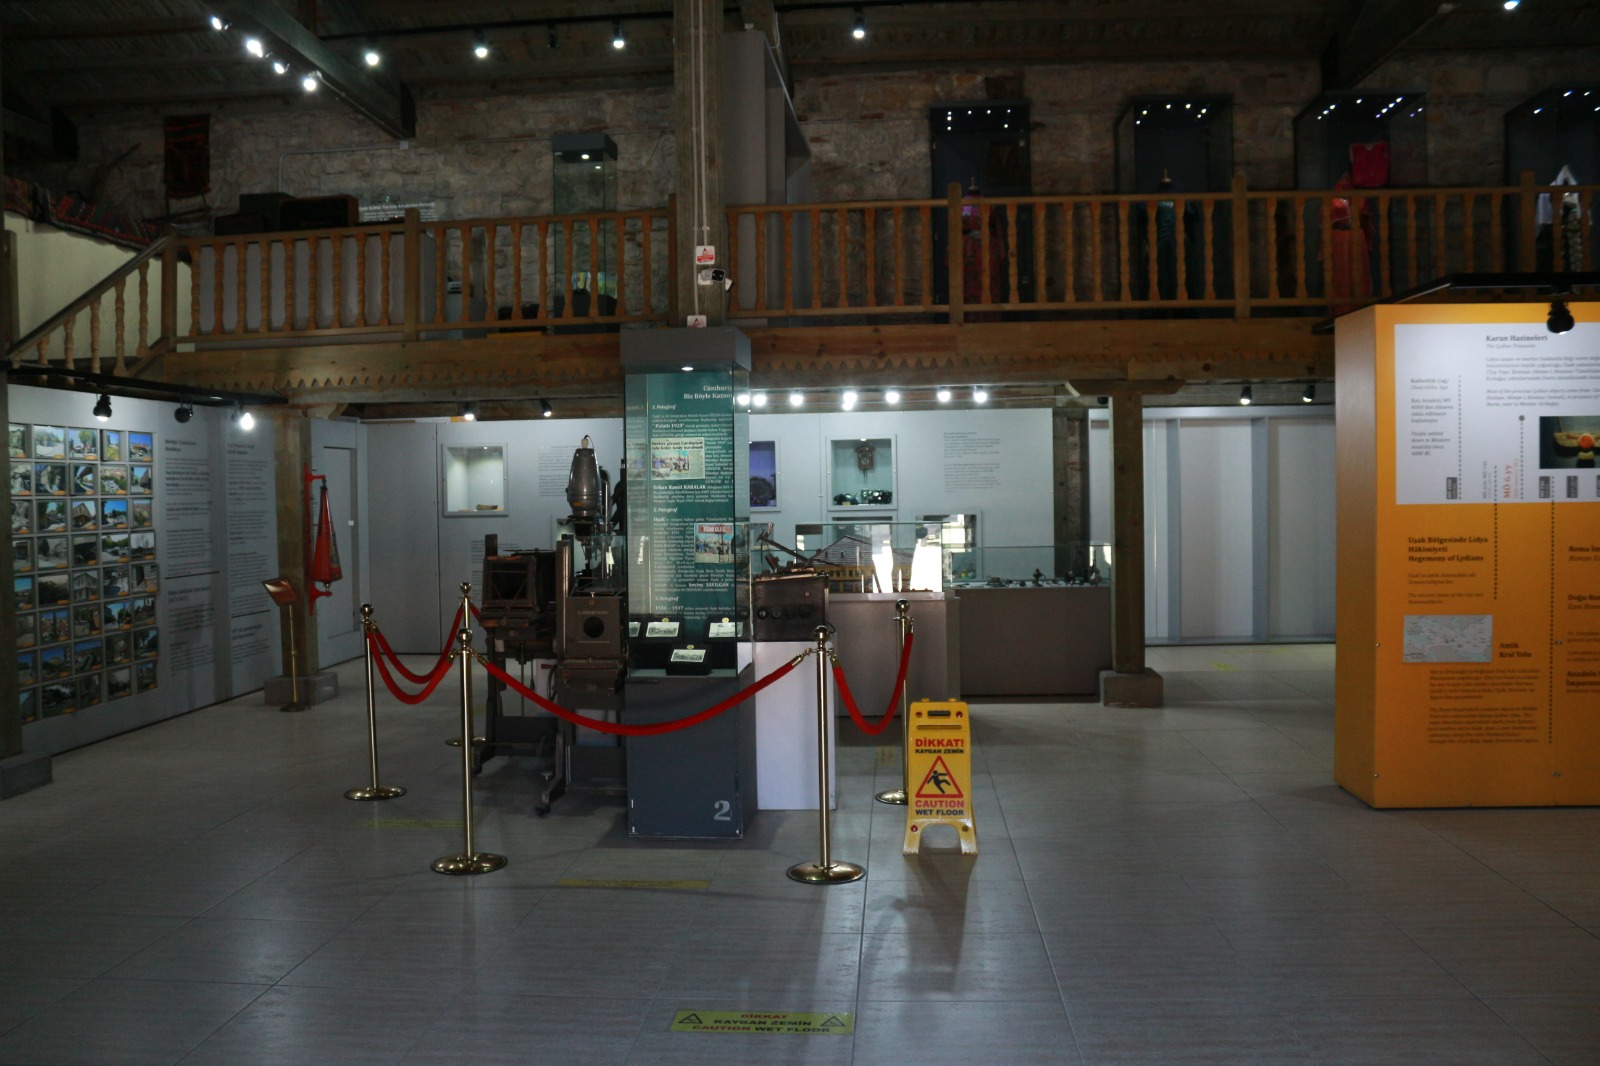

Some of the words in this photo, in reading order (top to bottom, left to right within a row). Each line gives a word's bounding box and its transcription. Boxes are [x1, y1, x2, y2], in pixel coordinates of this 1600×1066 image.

[1504, 464, 1512, 482] 6.yy
[1503, 484, 1511, 498] MÖ
[1427, 536, 1467, 544] Bölgesinde
[1468, 536, 1488, 544] Lidya
[1408, 555, 1446, 563] Hegemony
[915, 737, 964, 747] DİKKAT!
[915, 800, 964, 808] CAUTION
[713, 800, 731, 821] 2
[713, 1018, 768, 1026] KAYGAN
